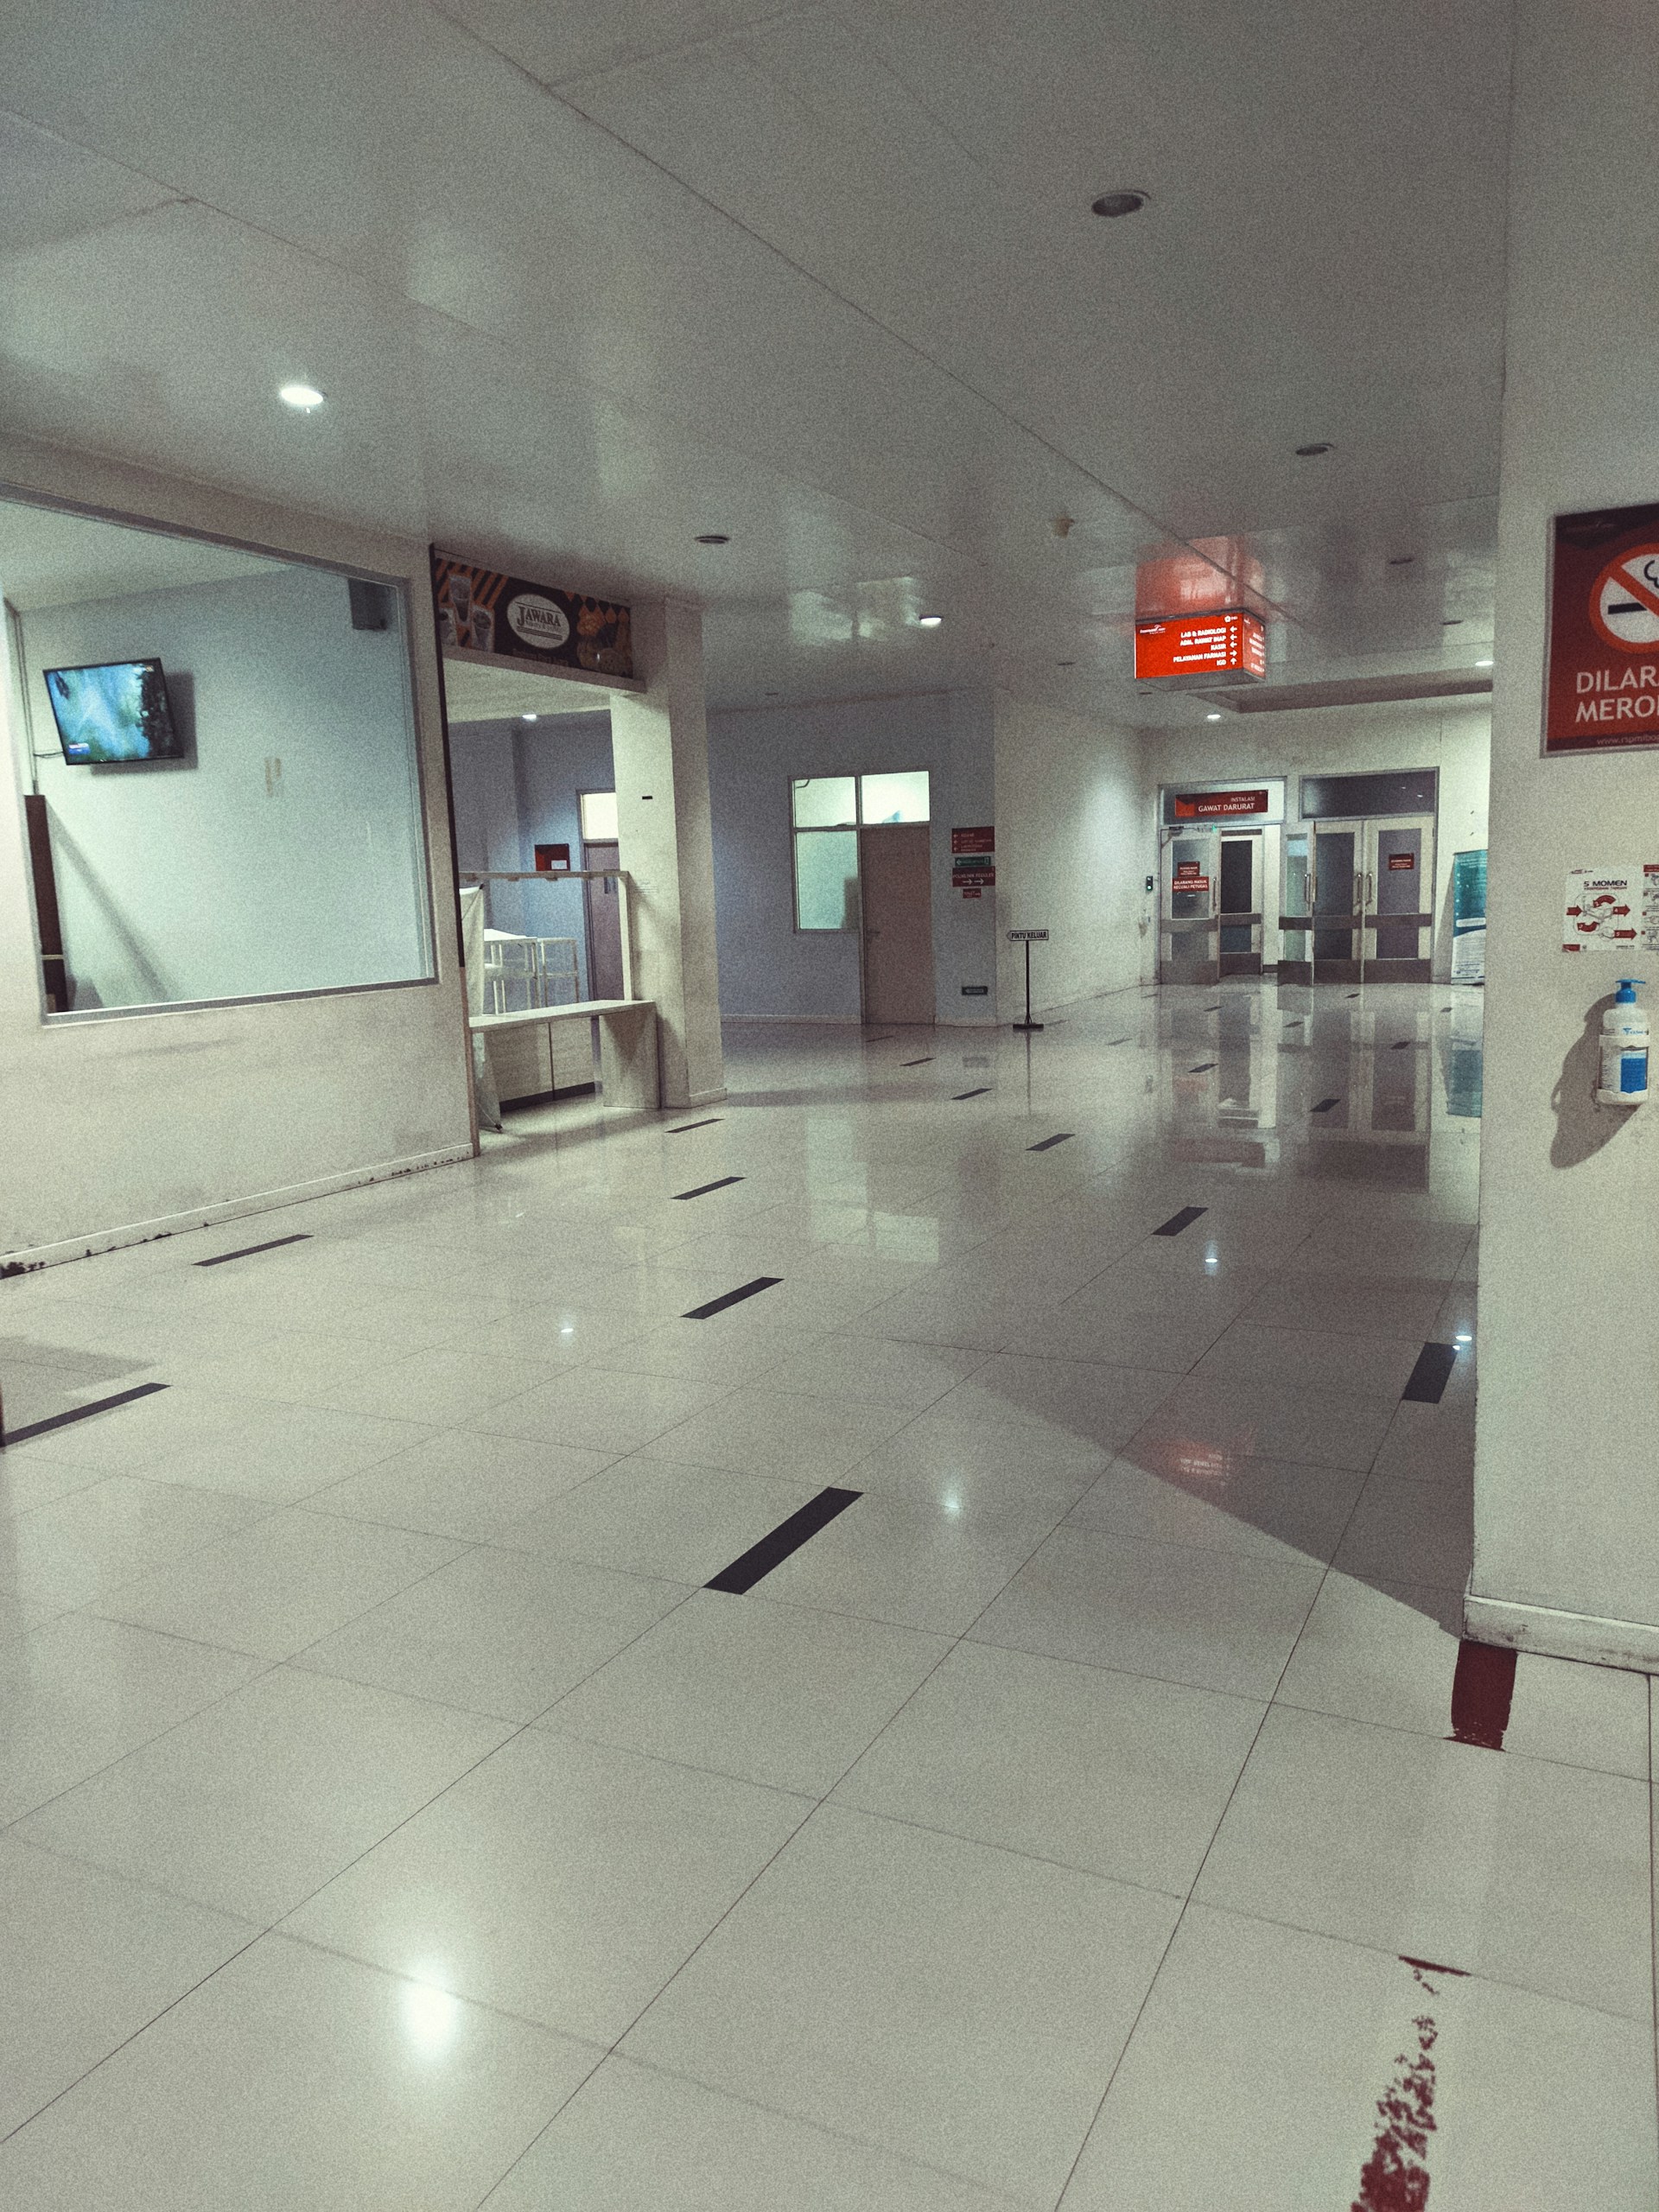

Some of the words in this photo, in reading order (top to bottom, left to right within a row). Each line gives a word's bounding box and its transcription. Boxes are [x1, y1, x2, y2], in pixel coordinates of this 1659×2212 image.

[517, 606, 561, 627] JAWARA
[1198, 627, 1226, 636] RADIOLOGI
[1173, 653, 1203, 663] PELAYANAN
[1204, 651, 1226, 659] FARMASI
[1576, 665, 1659, 694] DILAR
[1575, 695, 1659, 723] MERO
